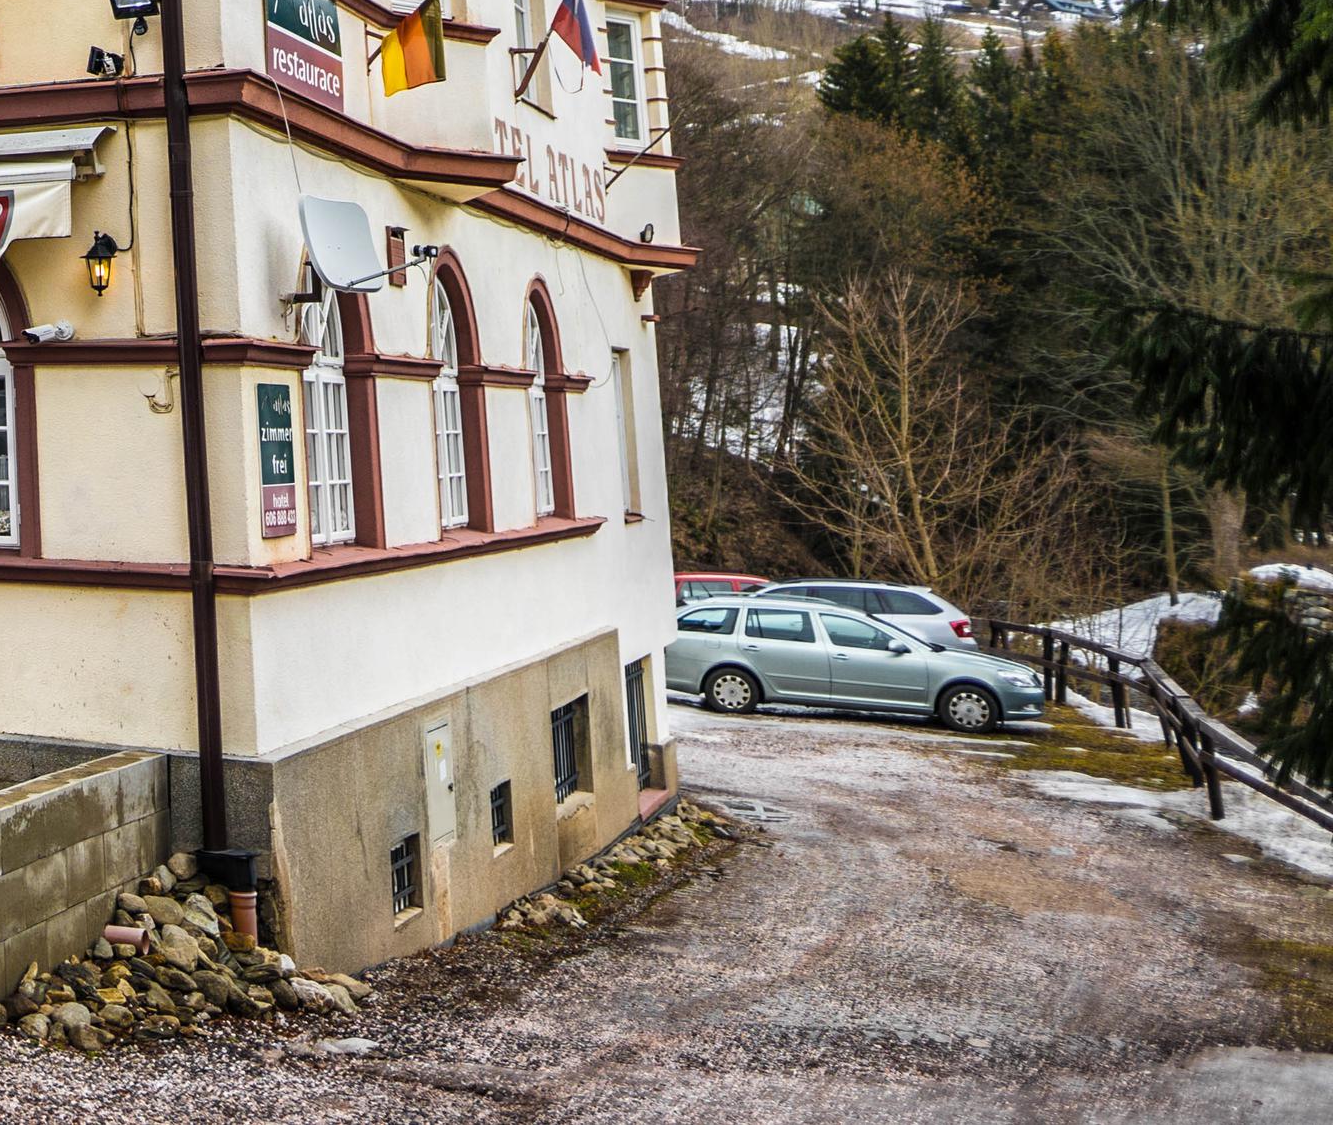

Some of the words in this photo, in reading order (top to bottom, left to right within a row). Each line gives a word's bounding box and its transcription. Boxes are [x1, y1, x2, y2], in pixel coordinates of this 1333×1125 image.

[272, 46, 341, 97] restaurace
[546, 144, 606, 226] ATLAS
[261, 421, 293, 442] zimmer
[272, 453, 288, 475] frei
[272, 492, 290, 508] hotel
